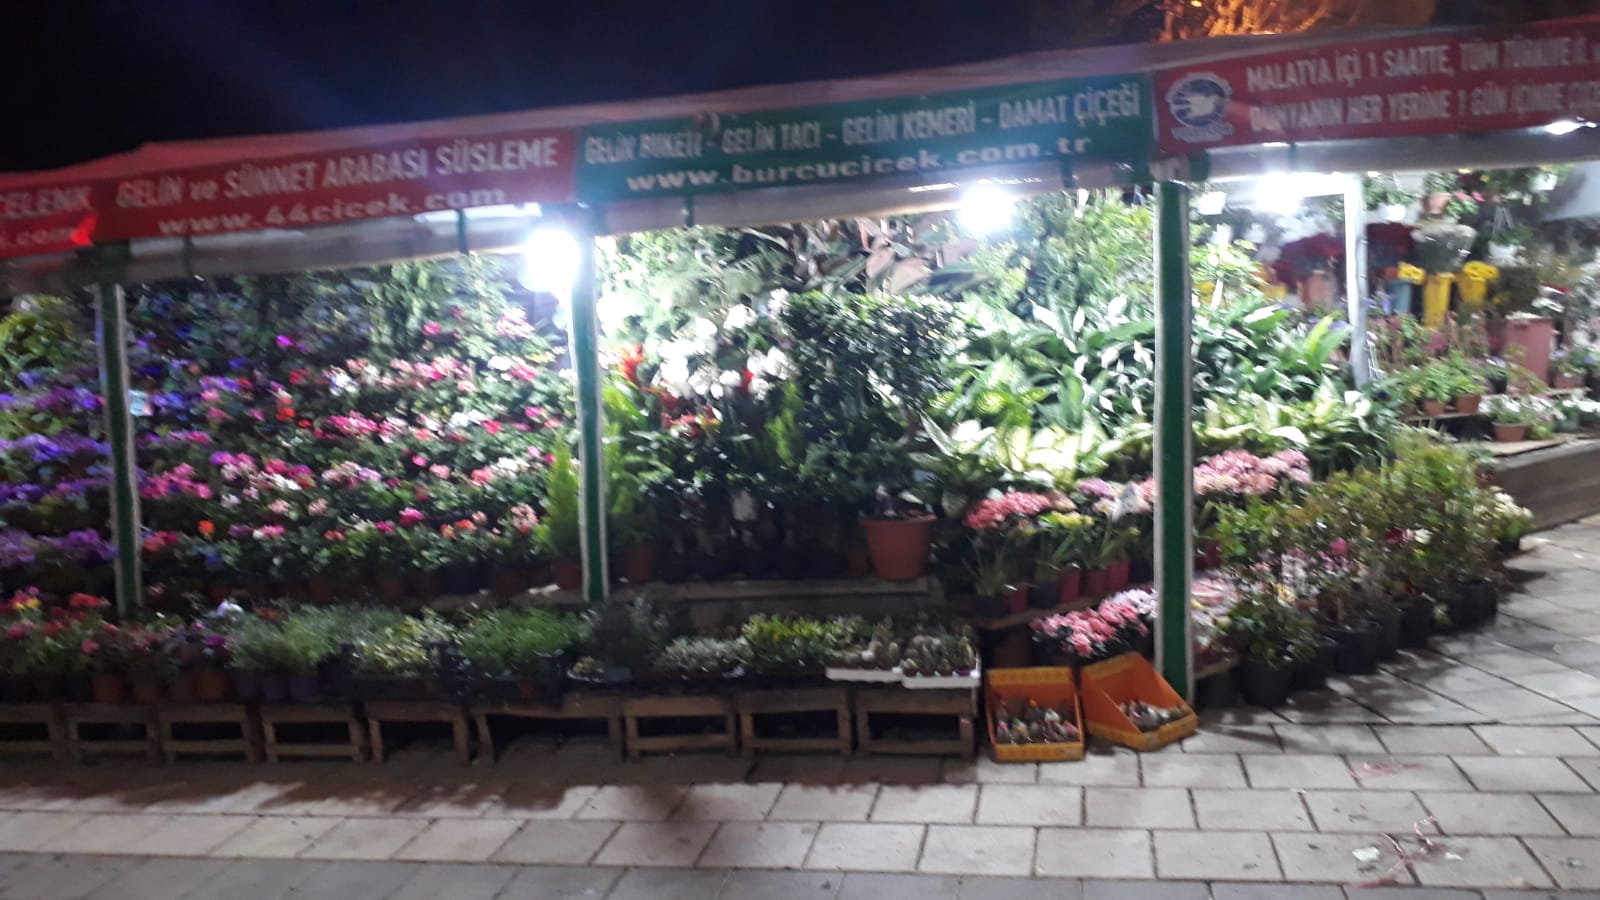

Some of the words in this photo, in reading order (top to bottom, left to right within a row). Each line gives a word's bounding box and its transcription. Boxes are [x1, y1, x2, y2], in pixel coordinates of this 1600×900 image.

[722, 120, 775, 155] GELİN
[780, 120, 821, 150] TACI
[842, 109, 898, 146] GELİN
[901, 98, 977, 141] KEMERİ
[999, 95, 1069, 130] DAMAT
[1073, 80, 1141, 129] ÇİÇEĞİ
[322, 148, 428, 188] ARABASI
[435, 137, 559, 176] SÜSLEME
